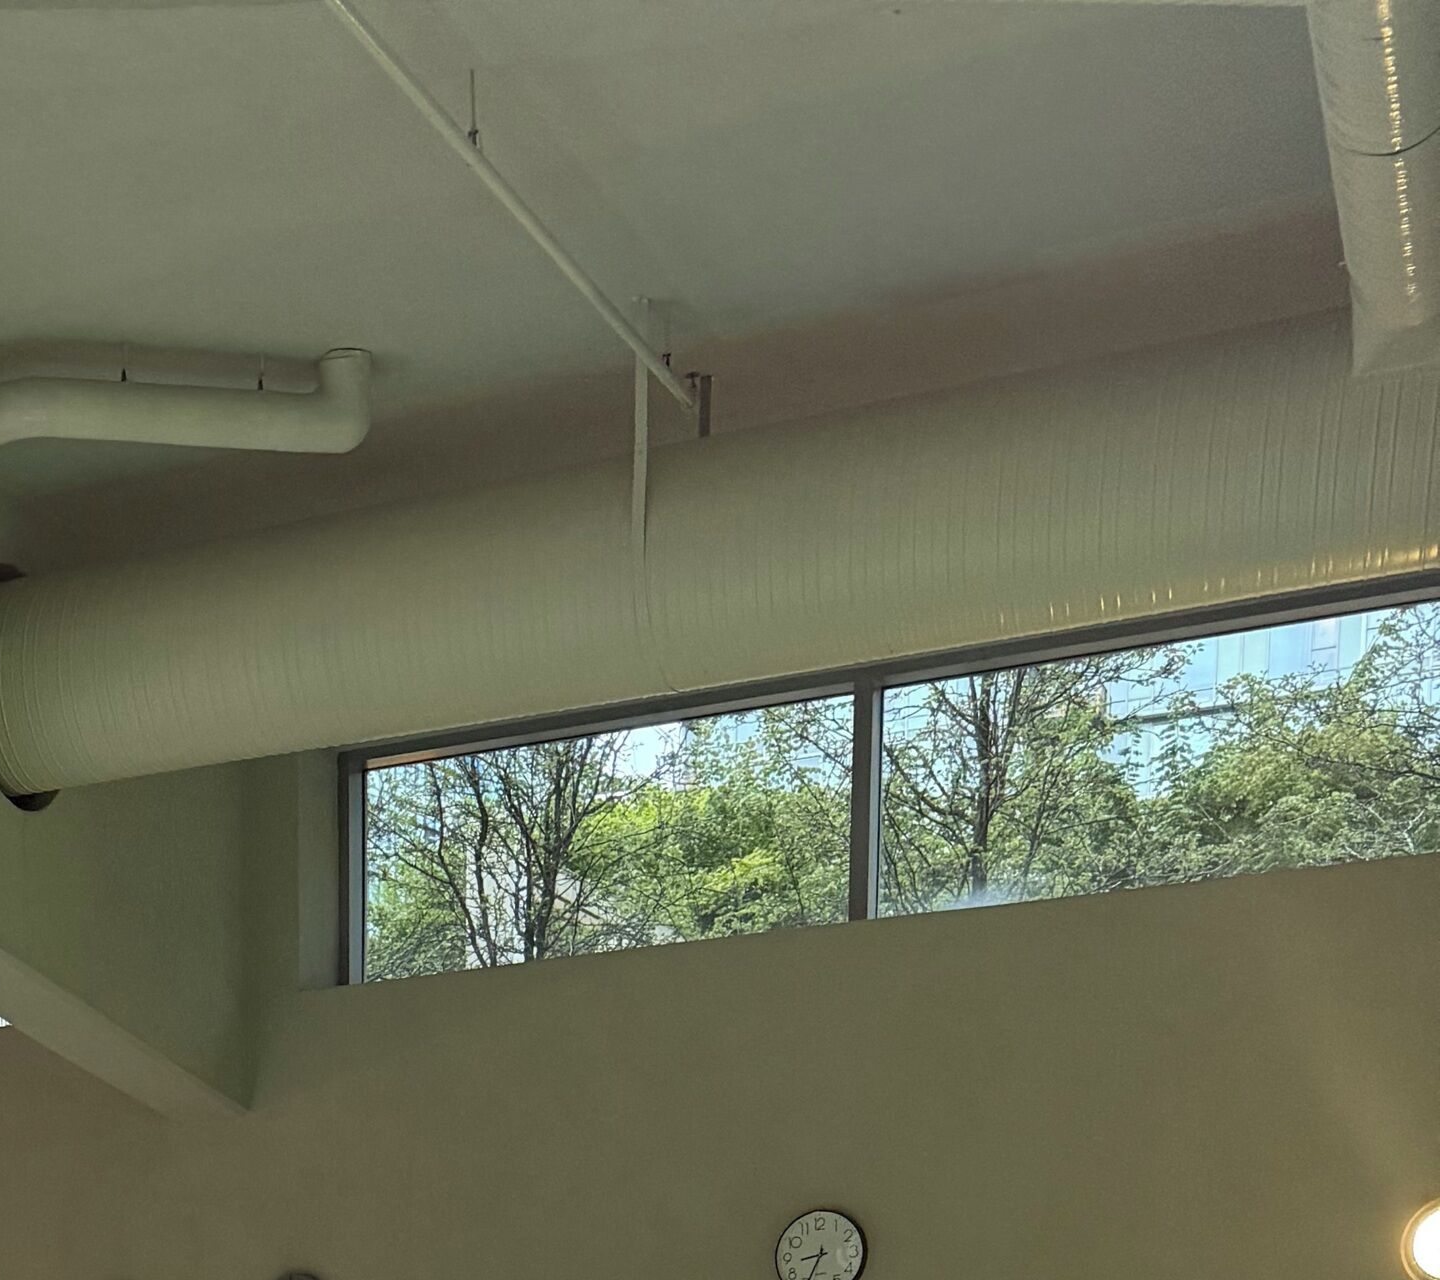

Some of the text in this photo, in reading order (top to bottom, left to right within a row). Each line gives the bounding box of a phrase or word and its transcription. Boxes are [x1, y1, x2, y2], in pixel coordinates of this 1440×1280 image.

[799, 1222, 809, 1235] 11
[814, 1217, 825, 1231] 12
[789, 1236, 802, 1249] 10
[844, 1229, 853, 1243] 2
[849, 1245, 859, 1258] 3
[783, 1252, 792, 1265] 9
[788, 1267, 797, 1280] 8
[844, 1262, 853, 1274] 4
